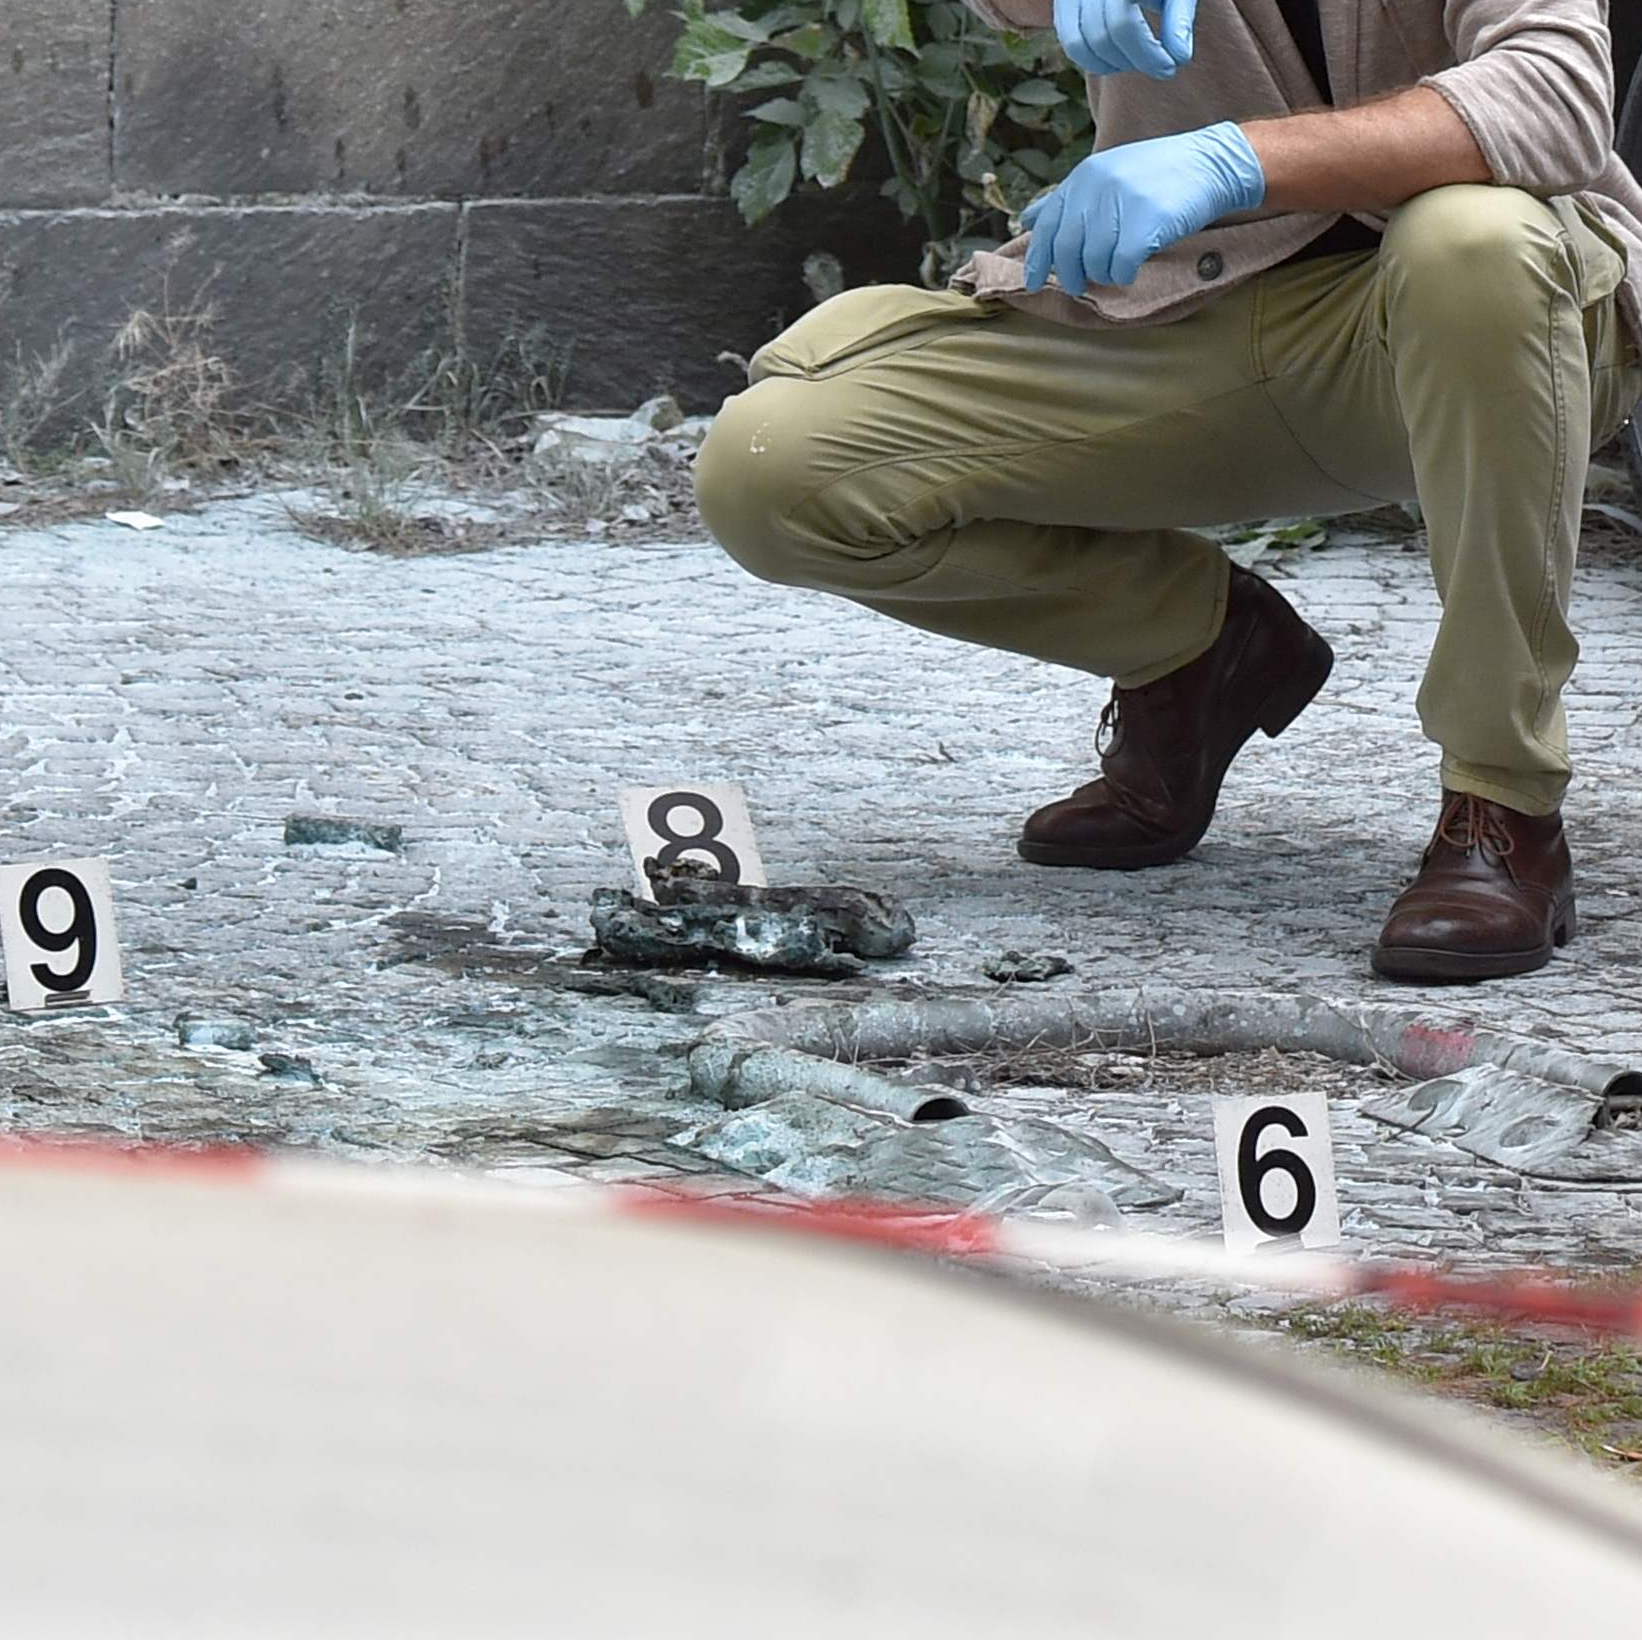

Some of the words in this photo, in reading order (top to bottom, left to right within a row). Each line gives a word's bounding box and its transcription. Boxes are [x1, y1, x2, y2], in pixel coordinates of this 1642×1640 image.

[647, 791, 741, 885] 8
[19, 868, 97, 992] 9
[1237, 1105, 1317, 1236] 6
